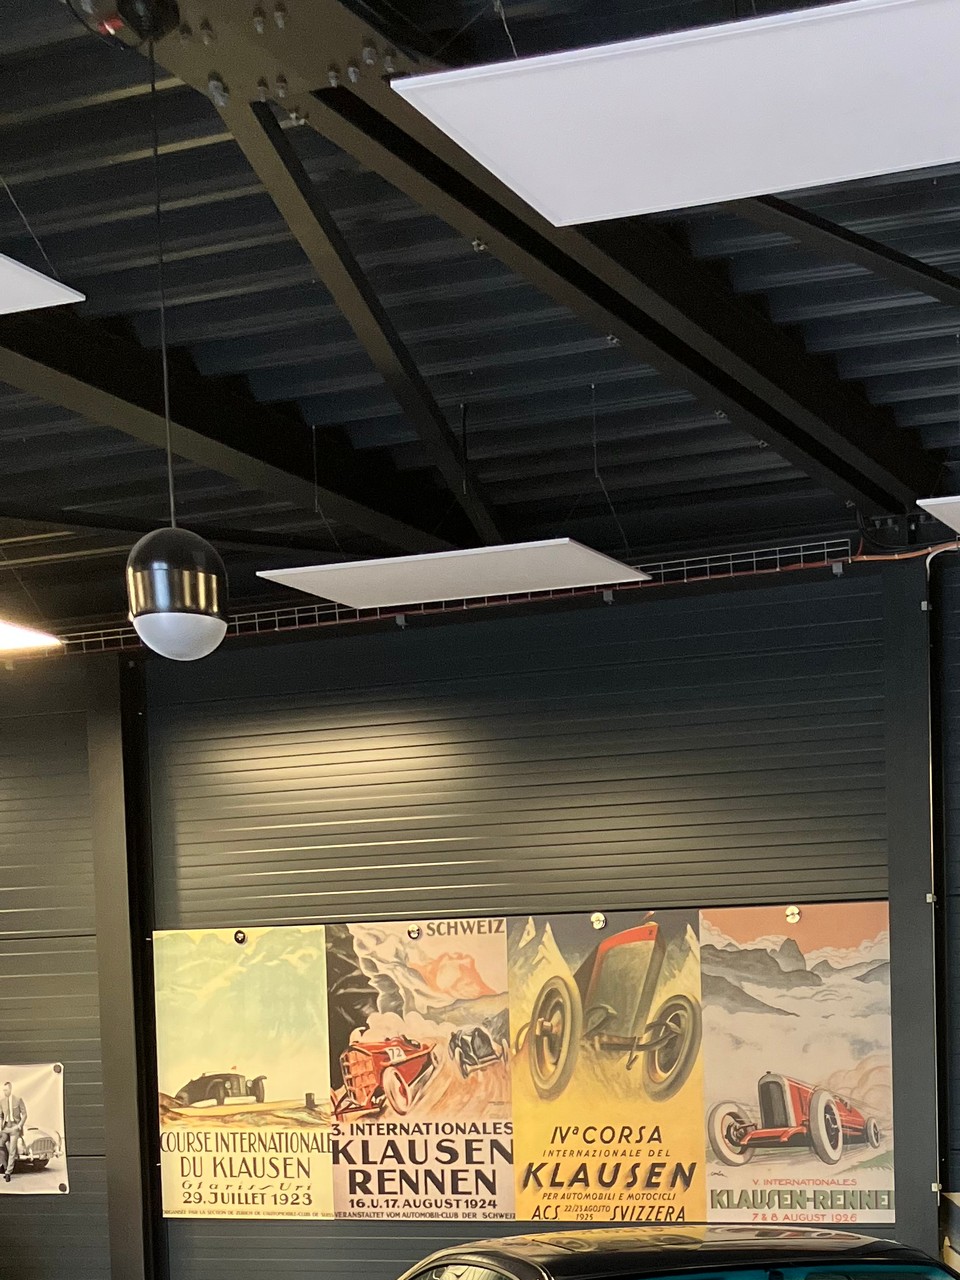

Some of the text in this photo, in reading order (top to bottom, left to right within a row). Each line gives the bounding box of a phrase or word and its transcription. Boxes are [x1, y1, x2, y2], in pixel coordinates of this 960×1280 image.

[426, 919, 505, 936] SCHWEIZ
[332, 1122, 513, 1136] 3. INTERNATIONALES
[583, 1126, 662, 1144] CORSA
[161, 1132, 212, 1152] COURSE
[332, 1139, 514, 1165] KLAUSEN
[181, 1156, 311, 1179] DU KLAUSEN
[522, 1162, 697, 1190] KLAUSEN
[349, 1169, 497, 1195] RENNEN
[271, 1193, 312, 1205] 1923
[610, 1206, 685, 1221] SVIZZERA
[752, 1213, 759, 1221] 7
[771, 1213, 778, 1221] 8
[782, 1214, 826, 1222] AUGUST
[831, 1214, 857, 1222] 1926
